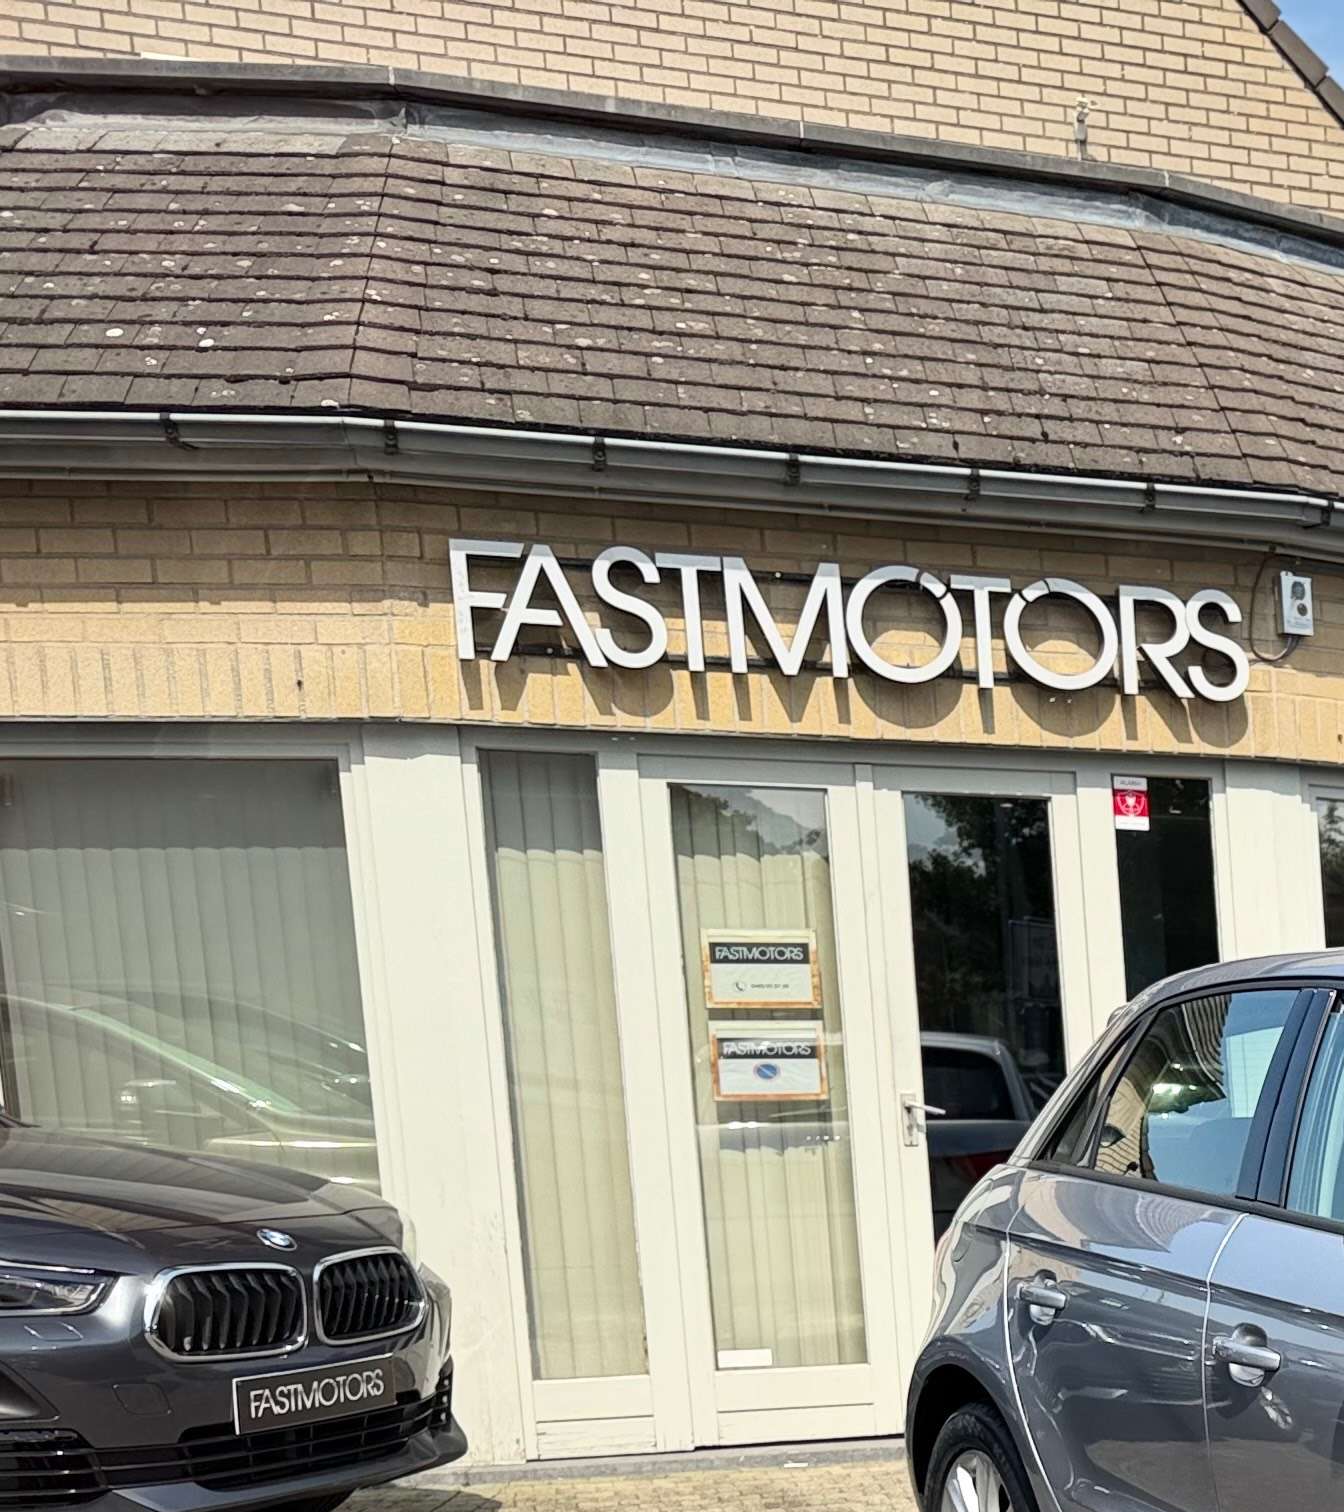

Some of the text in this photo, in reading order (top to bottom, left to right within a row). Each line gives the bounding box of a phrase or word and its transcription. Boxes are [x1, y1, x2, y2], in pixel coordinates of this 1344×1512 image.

[449, 539, 1250, 702] FASTMOTORS
[714, 946, 804, 961] FASTMOTORS
[249, 1368, 385, 1419] FASTMOTORS
